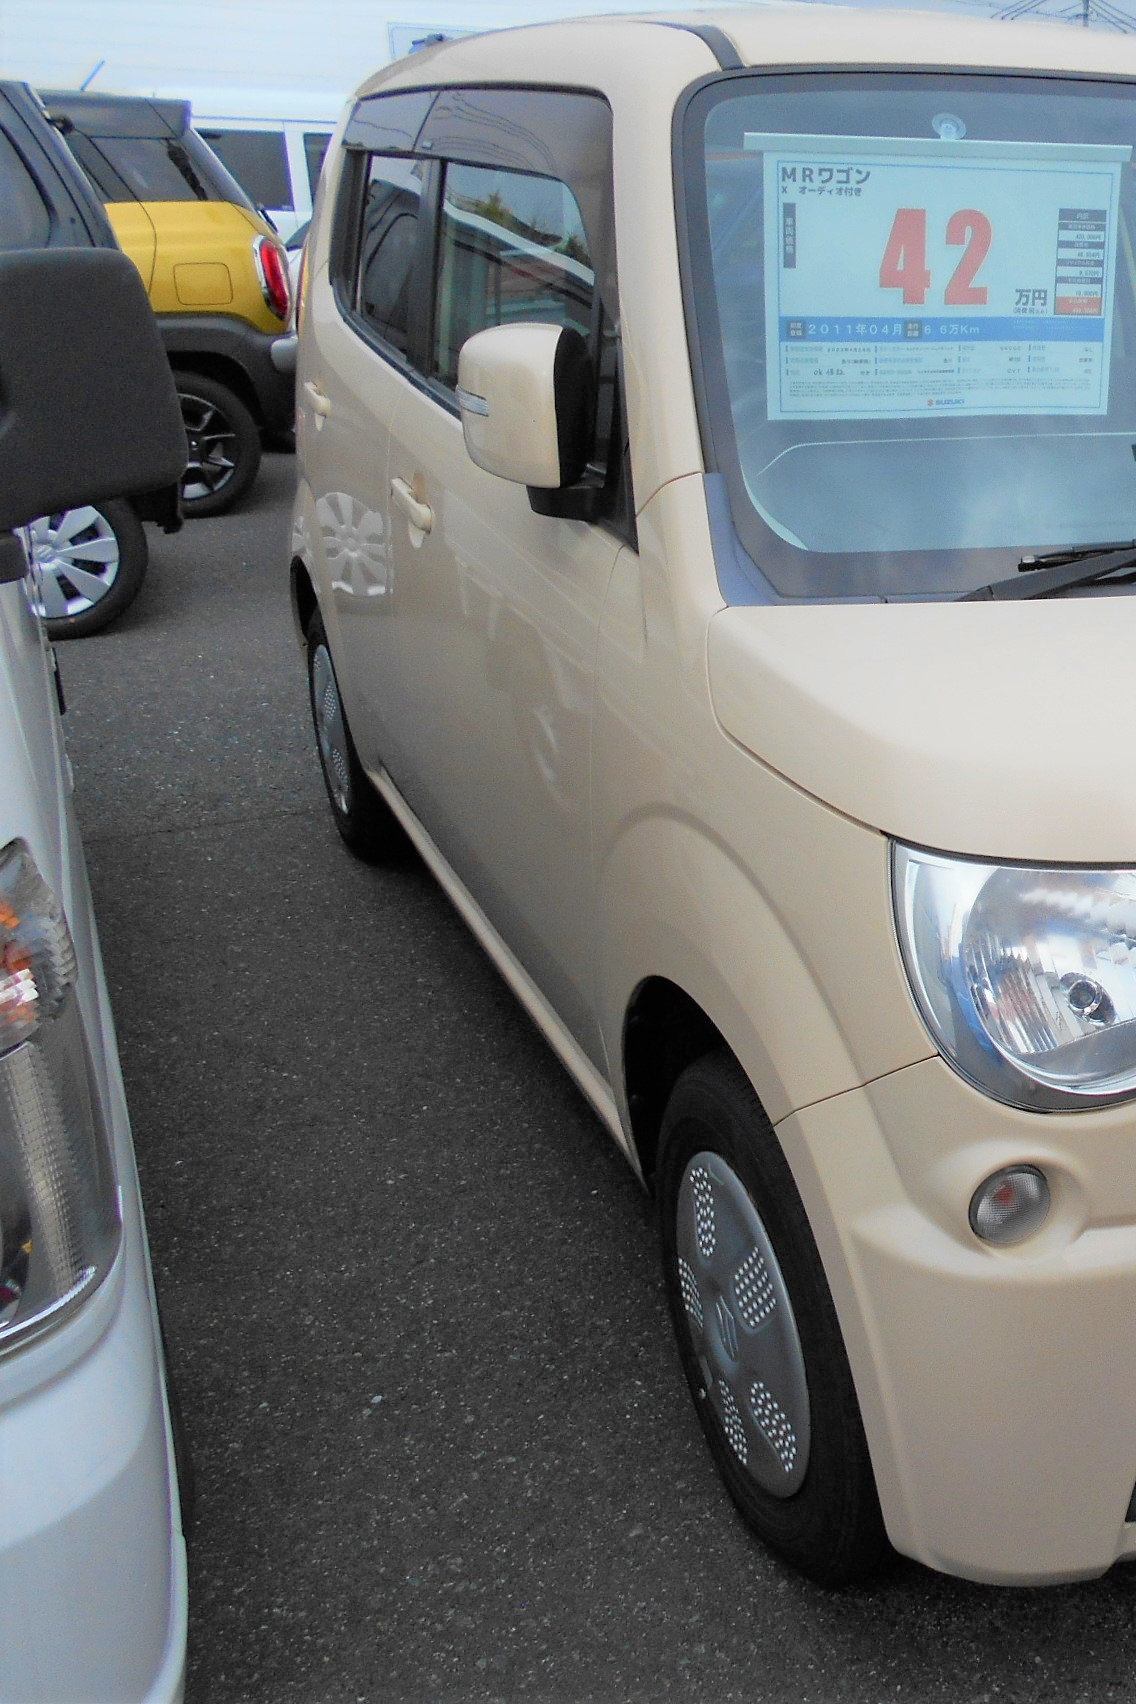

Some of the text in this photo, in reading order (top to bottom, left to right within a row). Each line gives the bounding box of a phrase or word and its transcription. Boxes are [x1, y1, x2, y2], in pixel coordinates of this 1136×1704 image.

[879, 208, 992, 305] 42
[1015, 289, 1047, 306] 万円
[808, 323, 902, 336] 2011年04月
